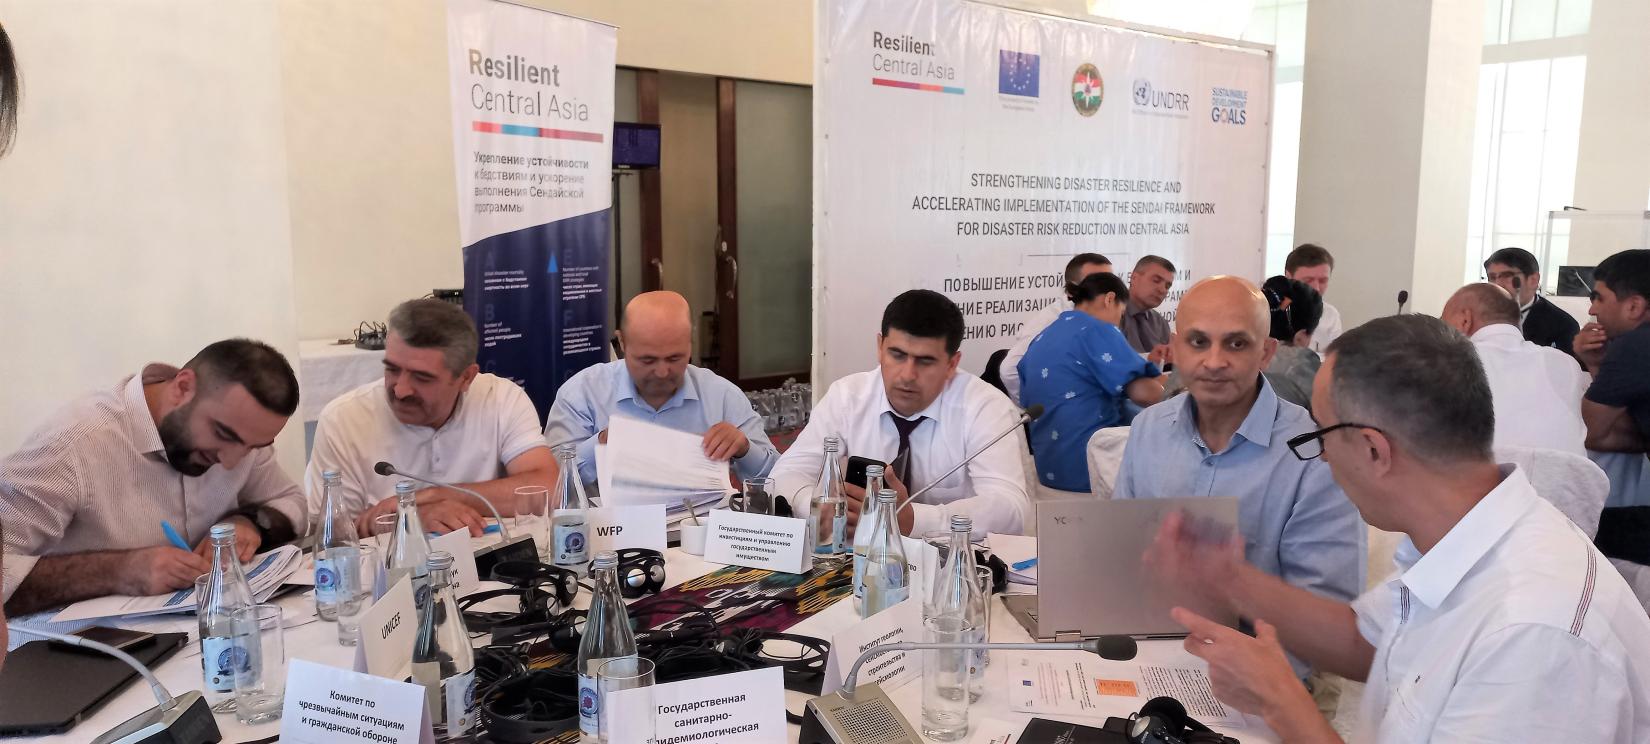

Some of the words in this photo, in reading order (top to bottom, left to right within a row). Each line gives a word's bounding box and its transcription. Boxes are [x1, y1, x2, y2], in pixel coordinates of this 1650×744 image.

[873, 31, 936, 57] Resilient
[469, 48, 560, 87] Resilient
[872, 53, 922, 76] Central
[926, 62, 955, 80] Asia
[471, 83, 541, 116] Central
[548, 94, 588, 121] Asia
[1152, 89, 1190, 111] UNDRR
[1212, 87, 1248, 99] SUSTAINABLE
[1211, 107, 1247, 125] GOALS
[474, 151, 525, 165] Укрепление
[527, 156, 589, 169] устойчивости
[480, 168, 528, 181] бедствиям
[539, 175, 584, 185] ускорение
[971, 173, 1061, 190] STRENGTHENING
[1064, 177, 1110, 191] DISASTER
[1112, 179, 1162, 193] RESILIENCE
[1164, 181, 1181, 193] AND
[474, 186, 527, 197] выполнения
[530, 186, 584, 199] Сендайской
[474, 203, 524, 214] программы
[912, 195, 1001, 211] ACCELERATING
[1004, 198, 1094, 213] IMPLEMENTATION
[1098, 200, 1109, 213] OF
[1112, 201, 1129, 213] THE
[1131, 202, 1163, 214] SENDAI
[1165, 202, 1215, 214] FRAMEWORK
[957, 221, 979, 236] FOR
[982, 222, 1034, 236] DISASTER
[1037, 222, 1060, 236] RISK
[1062, 222, 1116, 236] REDUCTION
[1118, 223, 1128, 235] IN
[1129, 223, 1168, 235] CENTRAL
[1170, 223, 1190, 235] ASIA
[944, 276, 1025, 292] ПОВЫШЕНИЕ
[1028, 272, 1063, 288] УСТОЙ
[597, 526, 623, 537] WFP
[718, 525, 762, 535] Государственный
[764, 530, 785, 538] комитет
[719, 534, 752, 543] инвестициям
[758, 539, 790, 547] управлению
[731, 544, 776, 553] государственным
[736, 553, 769, 562] имуществом
[381, 611, 401, 640] UNICEF
[859, 638, 880, 653] Институт
[868, 655, 901, 676] строительства
[329, 690, 364, 705] Комитет
[365, 700, 375, 708] по
[658, 694, 746, 714] Государственная
[299, 700, 359, 720] чрезвычайным
[360, 714, 405, 731] ситуациям
[674, 712, 732, 728] санитарно-
[302, 716, 307, 724] и
[308, 717, 361, 736] гражданской
[362, 729, 398, 744] обороне
